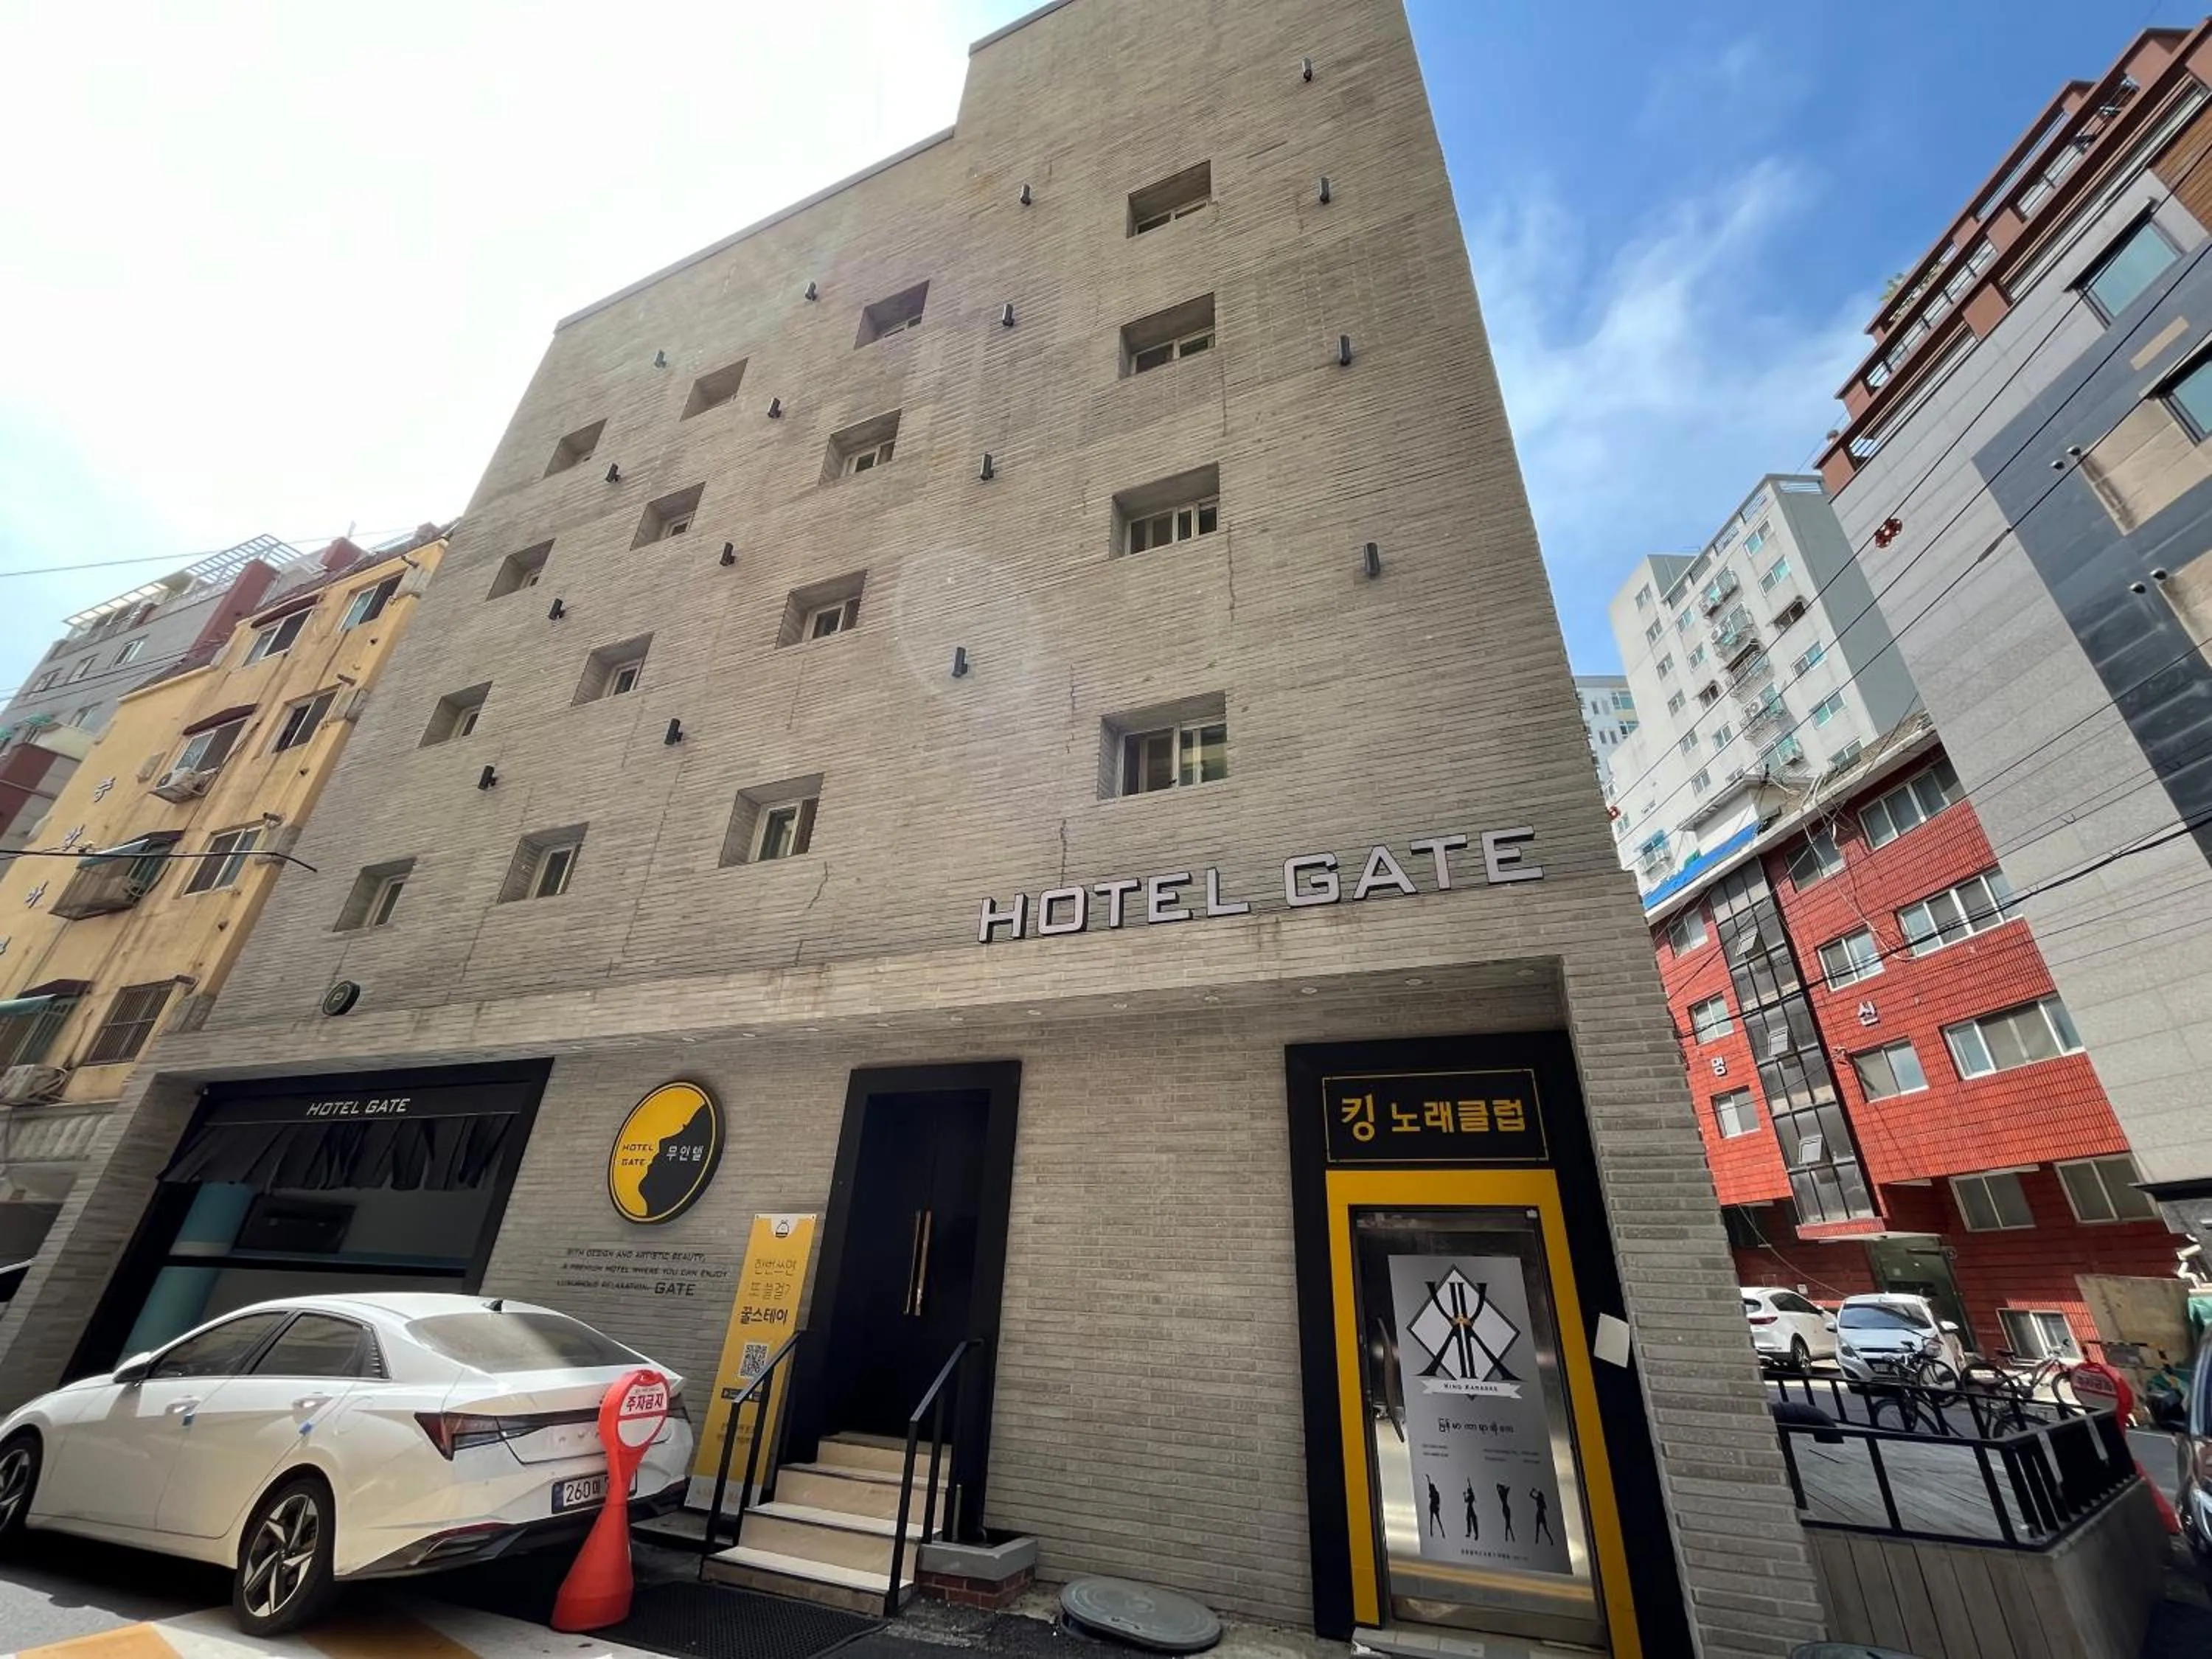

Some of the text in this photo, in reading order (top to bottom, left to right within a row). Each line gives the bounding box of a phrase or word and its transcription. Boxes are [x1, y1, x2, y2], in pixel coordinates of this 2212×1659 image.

[978, 825, 1544, 943] HOTEL GATE
[307, 1098, 410, 1116] HOTEL GATE
[1341, 1093, 1526, 1141] 킹 노래클럽
[667, 1144, 704, 1162] 무인텔
[616, 1251, 633, 1259] AND
[663, 1267, 678, 1276] YOU
[654, 1281, 696, 1296] GATE
[740, 1306, 788, 1326] 꿀스테이
[627, 1393, 664, 1412] 주차금지
